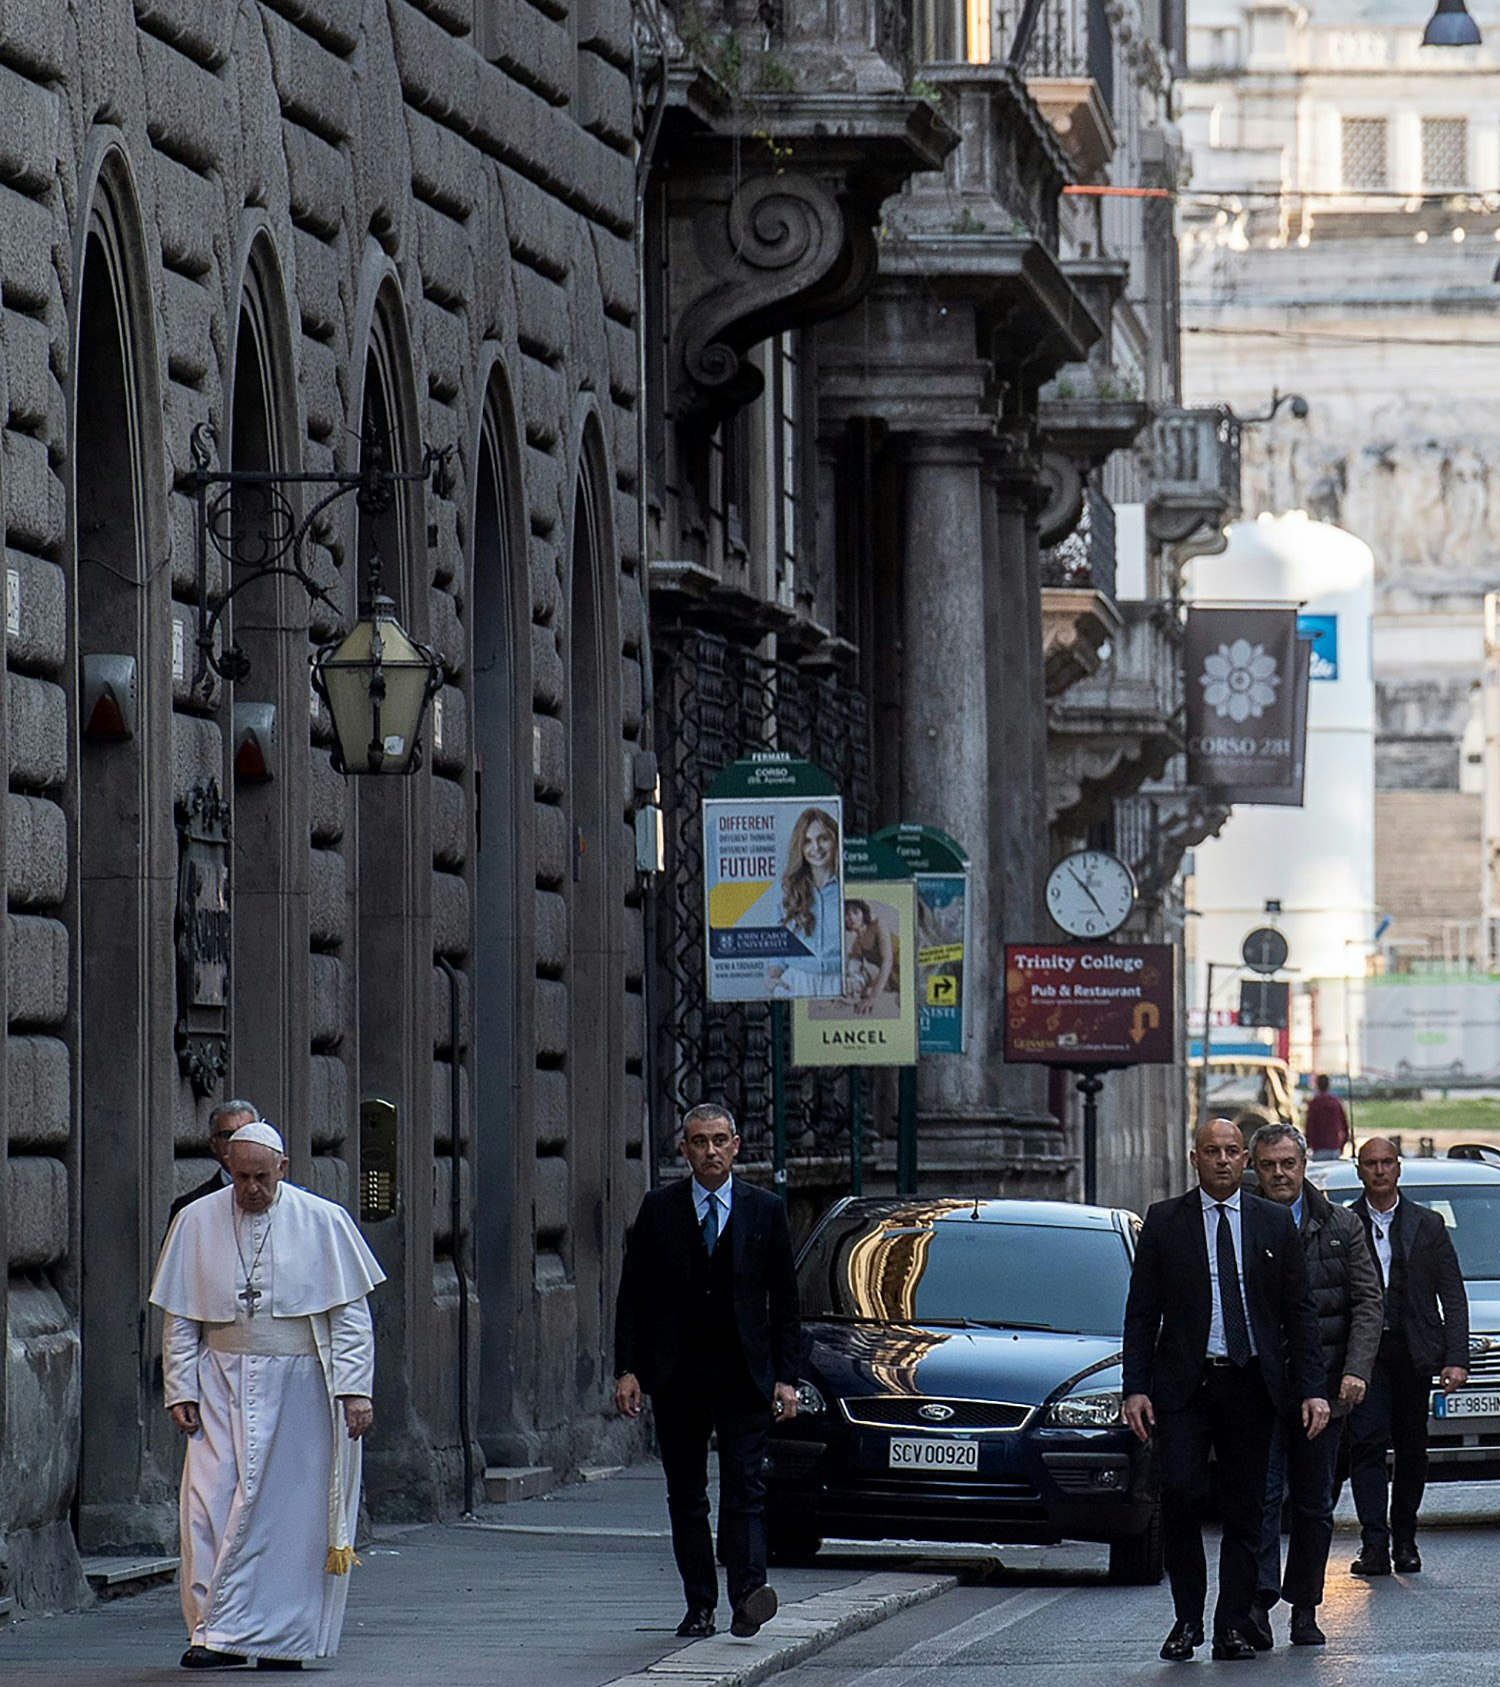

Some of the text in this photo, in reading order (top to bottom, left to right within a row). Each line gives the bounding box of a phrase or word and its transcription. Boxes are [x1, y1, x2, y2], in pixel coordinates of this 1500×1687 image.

[1188, 737, 1256, 756] CORSO
[751, 752, 791, 762] FERMATA
[755, 767, 788, 777] CORSO
[720, 815, 776, 831] DIFFERENT
[720, 856, 777, 878] FUTURE
[1082, 855, 1099, 869] 12
[1051, 887, 1061, 900] 9
[1085, 919, 1096, 933] 6
[737, 940, 788, 949] UNIVERSITY
[1014, 955, 1144, 973] Trinity College
[1031, 984, 1142, 997] Pub & Restaurant
[822, 1030, 887, 1044] LANCEL
[892, 1443, 976, 1465] SCV 00920
